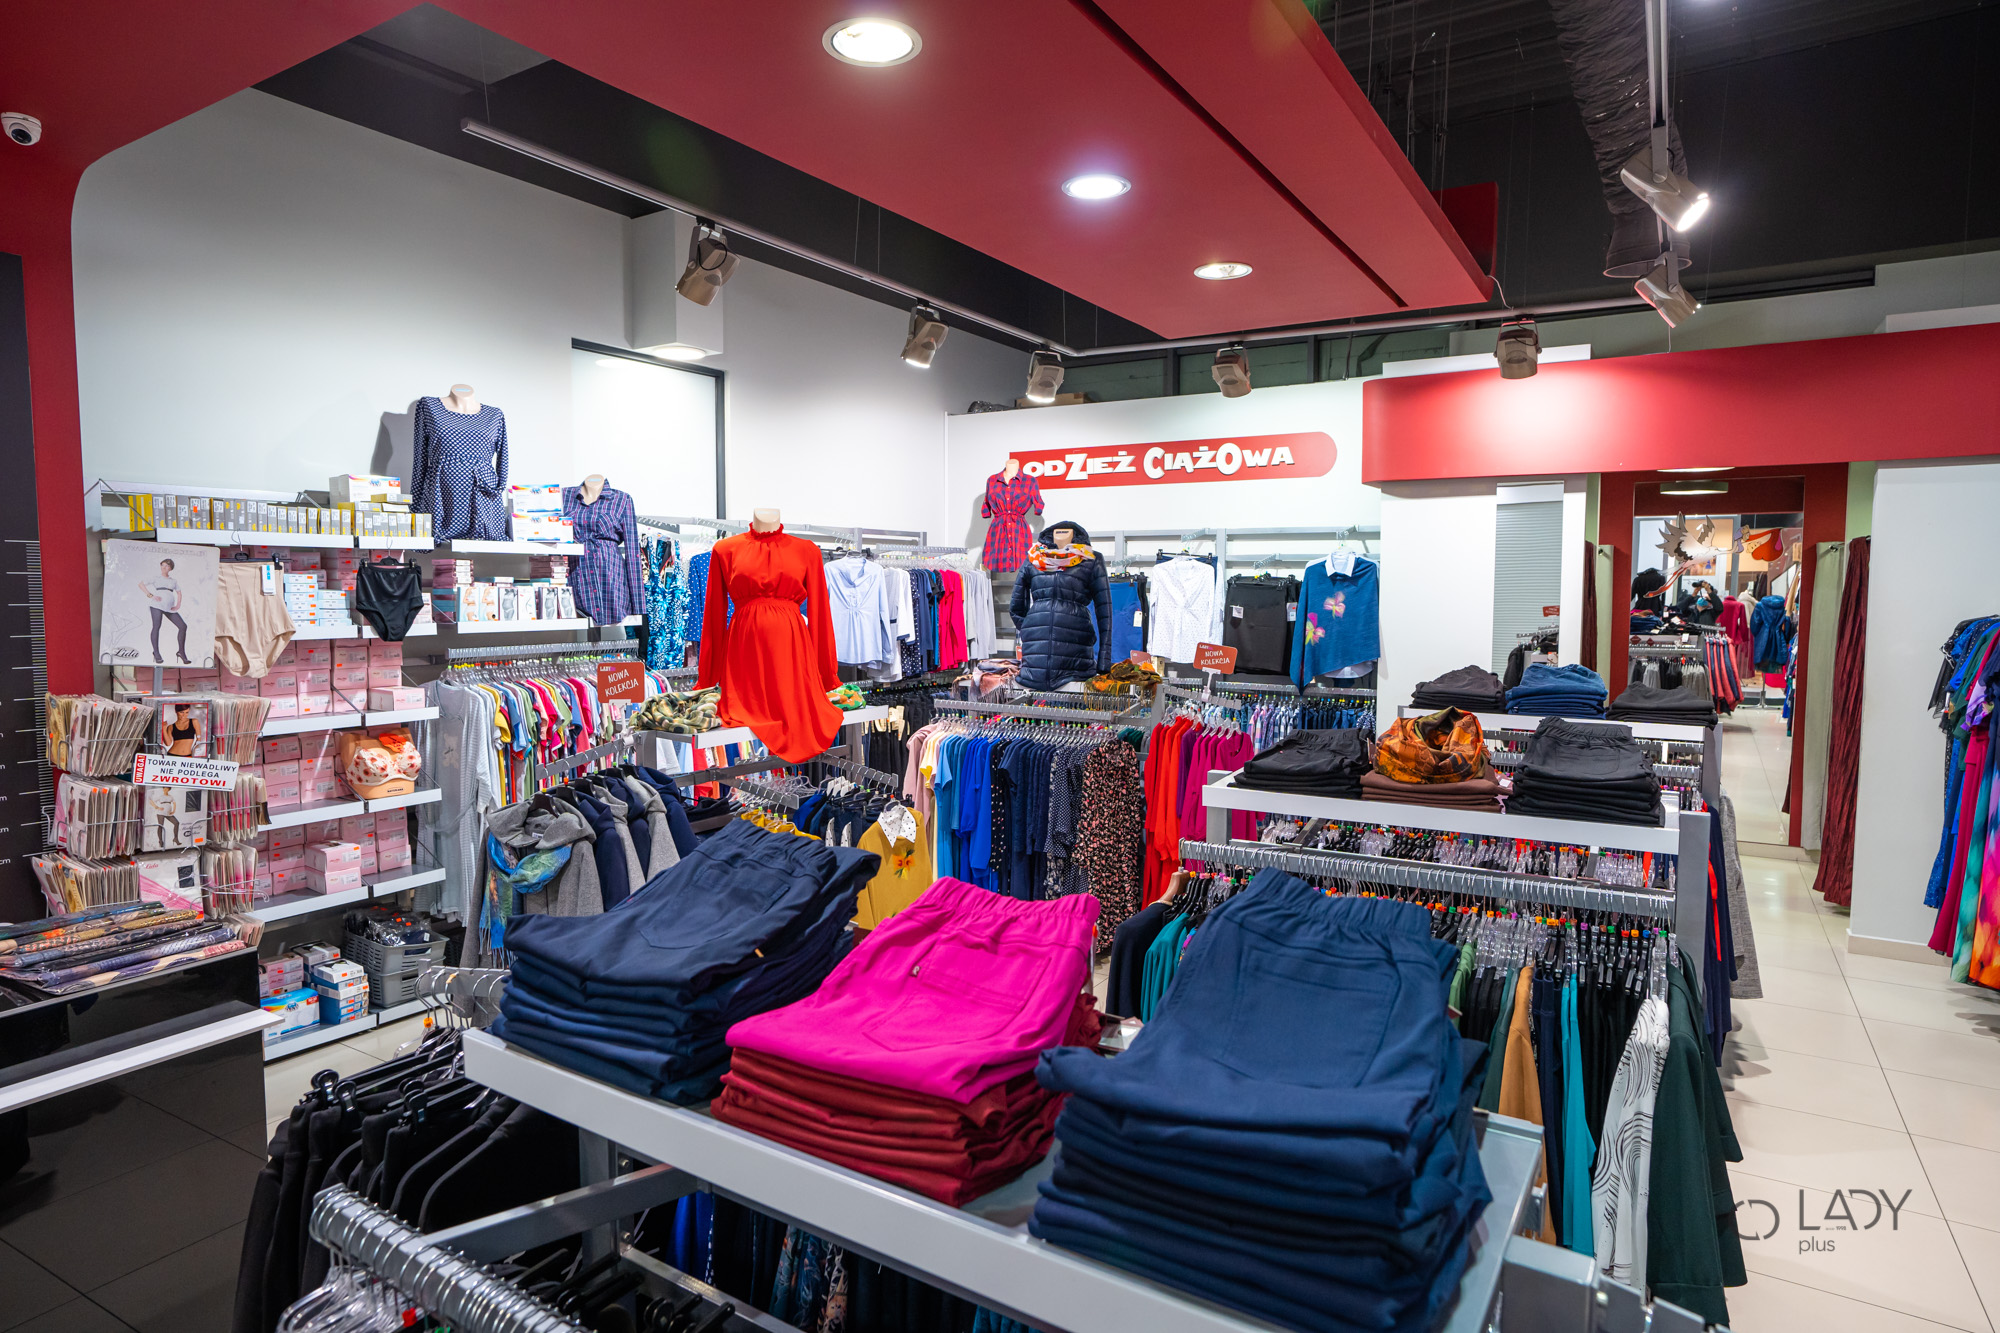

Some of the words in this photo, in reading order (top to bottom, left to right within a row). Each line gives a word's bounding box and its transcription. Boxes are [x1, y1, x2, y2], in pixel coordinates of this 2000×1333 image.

[1023, 451, 1136, 481] ODZIEŻ
[1143, 442, 1295, 479] CIĄŻOWA
[1200, 657, 1230, 666] KOLEKCJA
[608, 669, 629, 684] NOWA
[605, 678, 639, 697] KOLEKCJA
[136, 755, 145, 783] UWAGA!
[148, 758, 177, 767] TOWAR
[181, 762, 236, 772] NIEWADLIWY
[178, 769, 219, 778] PODLEGA
[152, 775, 226, 787] ZWROTOWI
